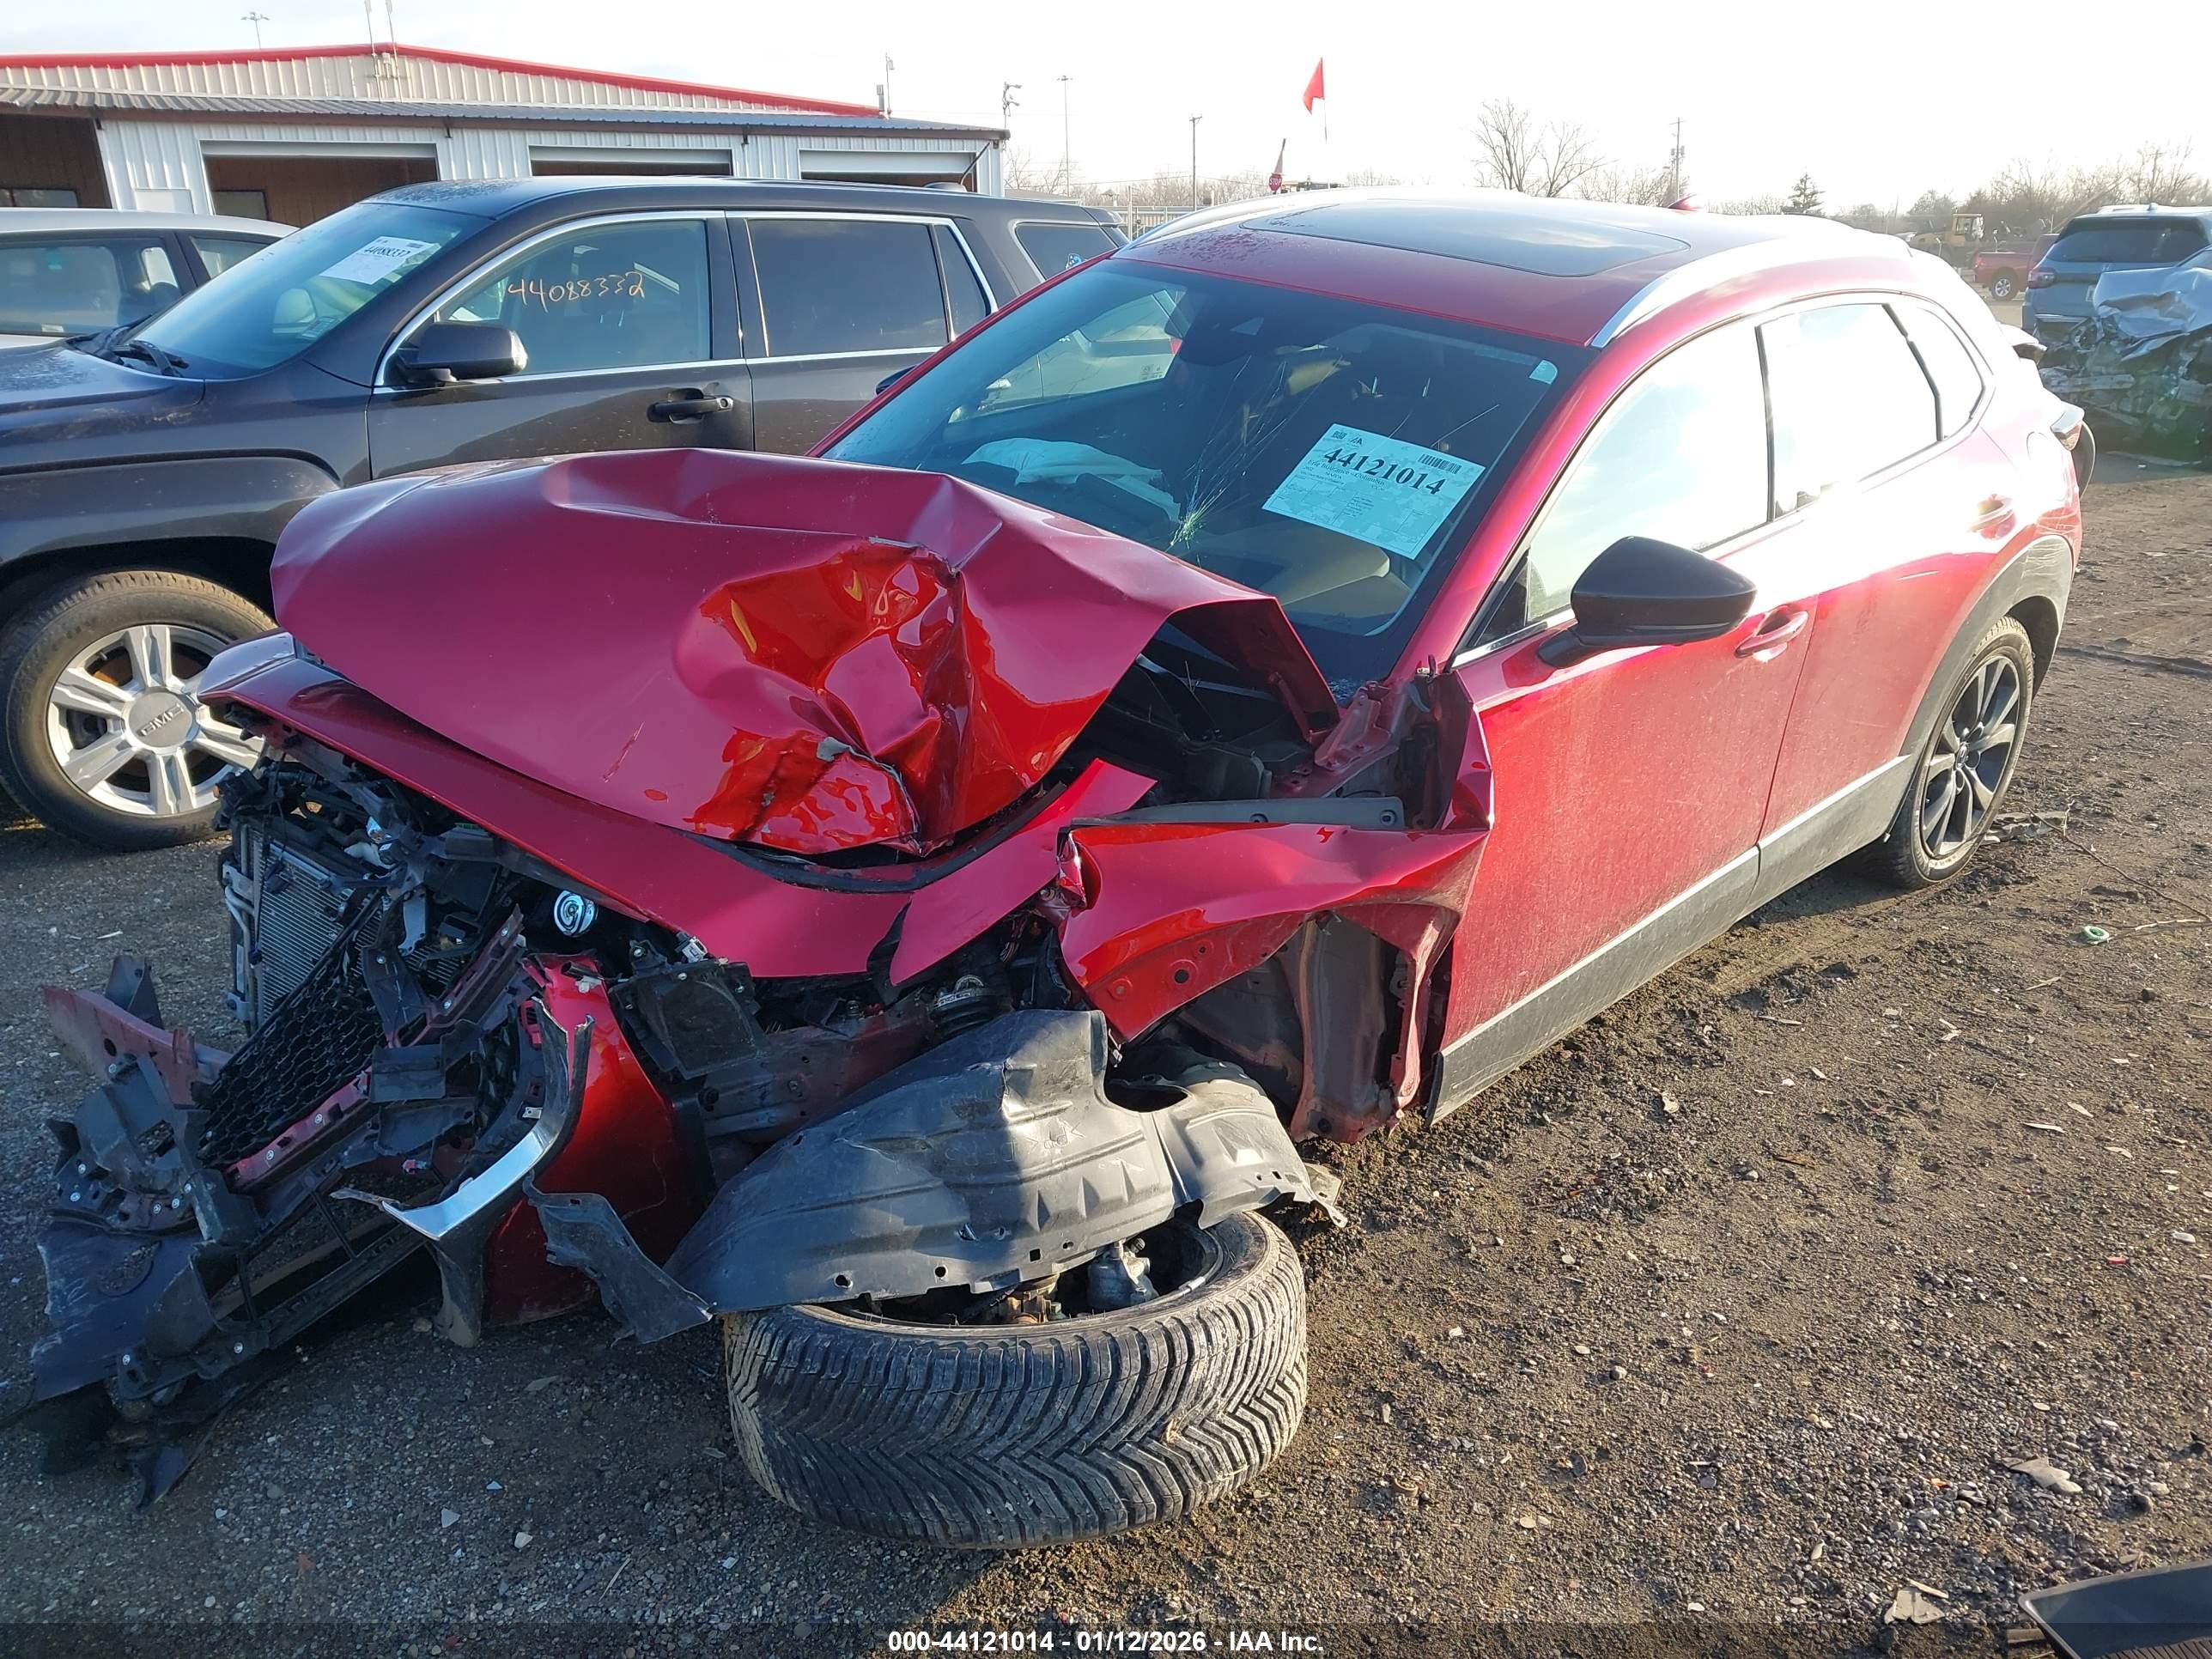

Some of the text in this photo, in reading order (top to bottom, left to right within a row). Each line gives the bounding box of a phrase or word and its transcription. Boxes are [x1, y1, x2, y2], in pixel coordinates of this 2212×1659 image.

[1269, 177, 1282, 185] STOP
[507, 270, 645, 313] 44088332
[1324, 447, 1447, 495] 44121014
[139, 702, 185, 738] GMC
